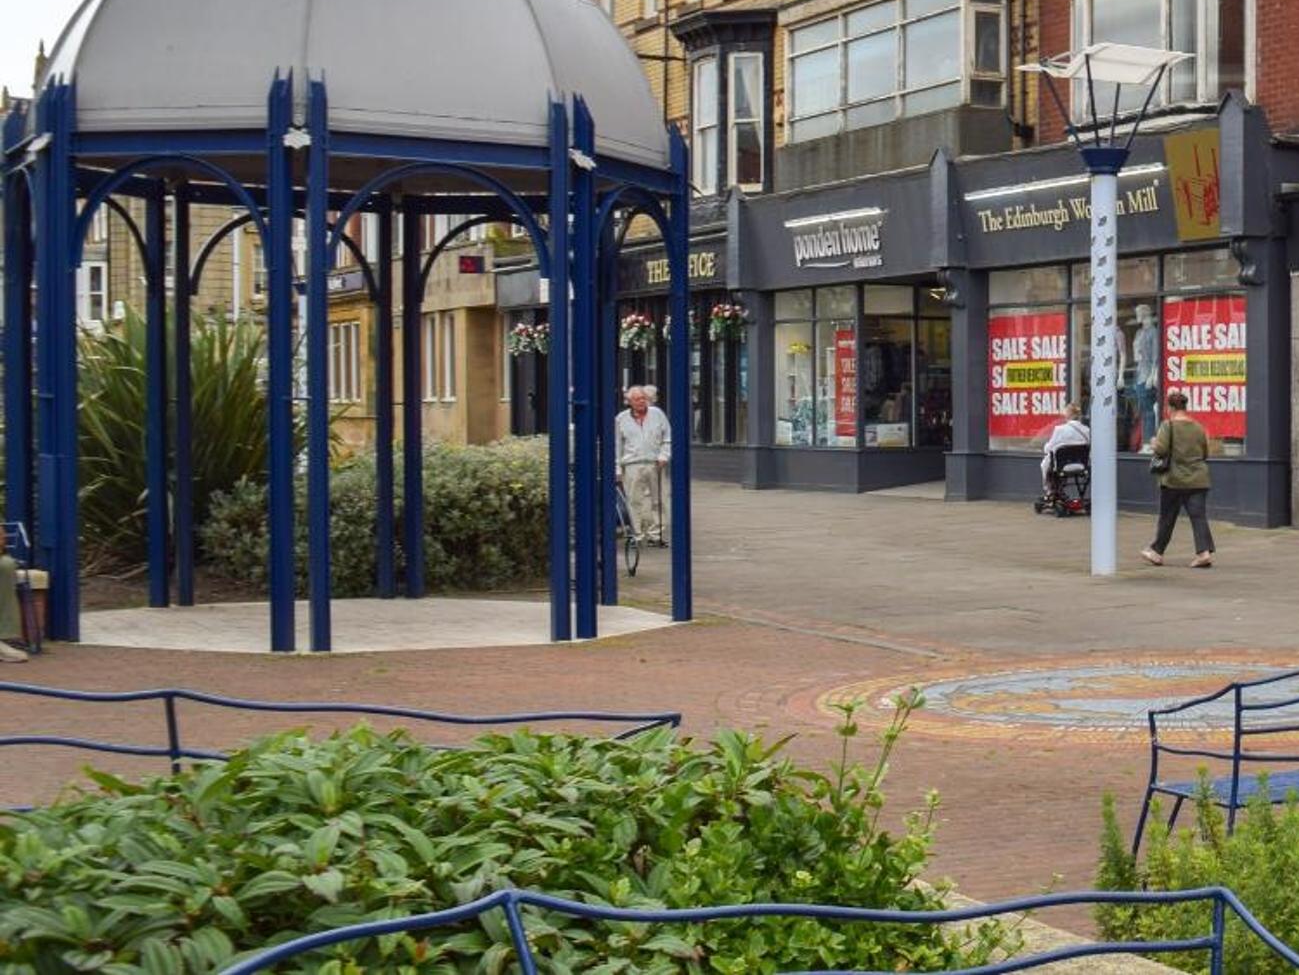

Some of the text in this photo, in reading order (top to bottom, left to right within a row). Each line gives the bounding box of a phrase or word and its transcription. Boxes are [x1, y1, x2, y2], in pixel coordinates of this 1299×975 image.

[978, 209, 1004, 233] The
[1005, 199, 1070, 231] Edinburgh
[1127, 186, 1159, 214] Mill
[794, 223, 880, 267] ponden home
[646, 252, 715, 284] THE FICE
[992, 335, 1067, 361] SALE SALE
[1167, 322, 1247, 352] SALE SAL
[992, 391, 1067, 416] SALE SALE
[1214, 385, 1247, 413] SAL
